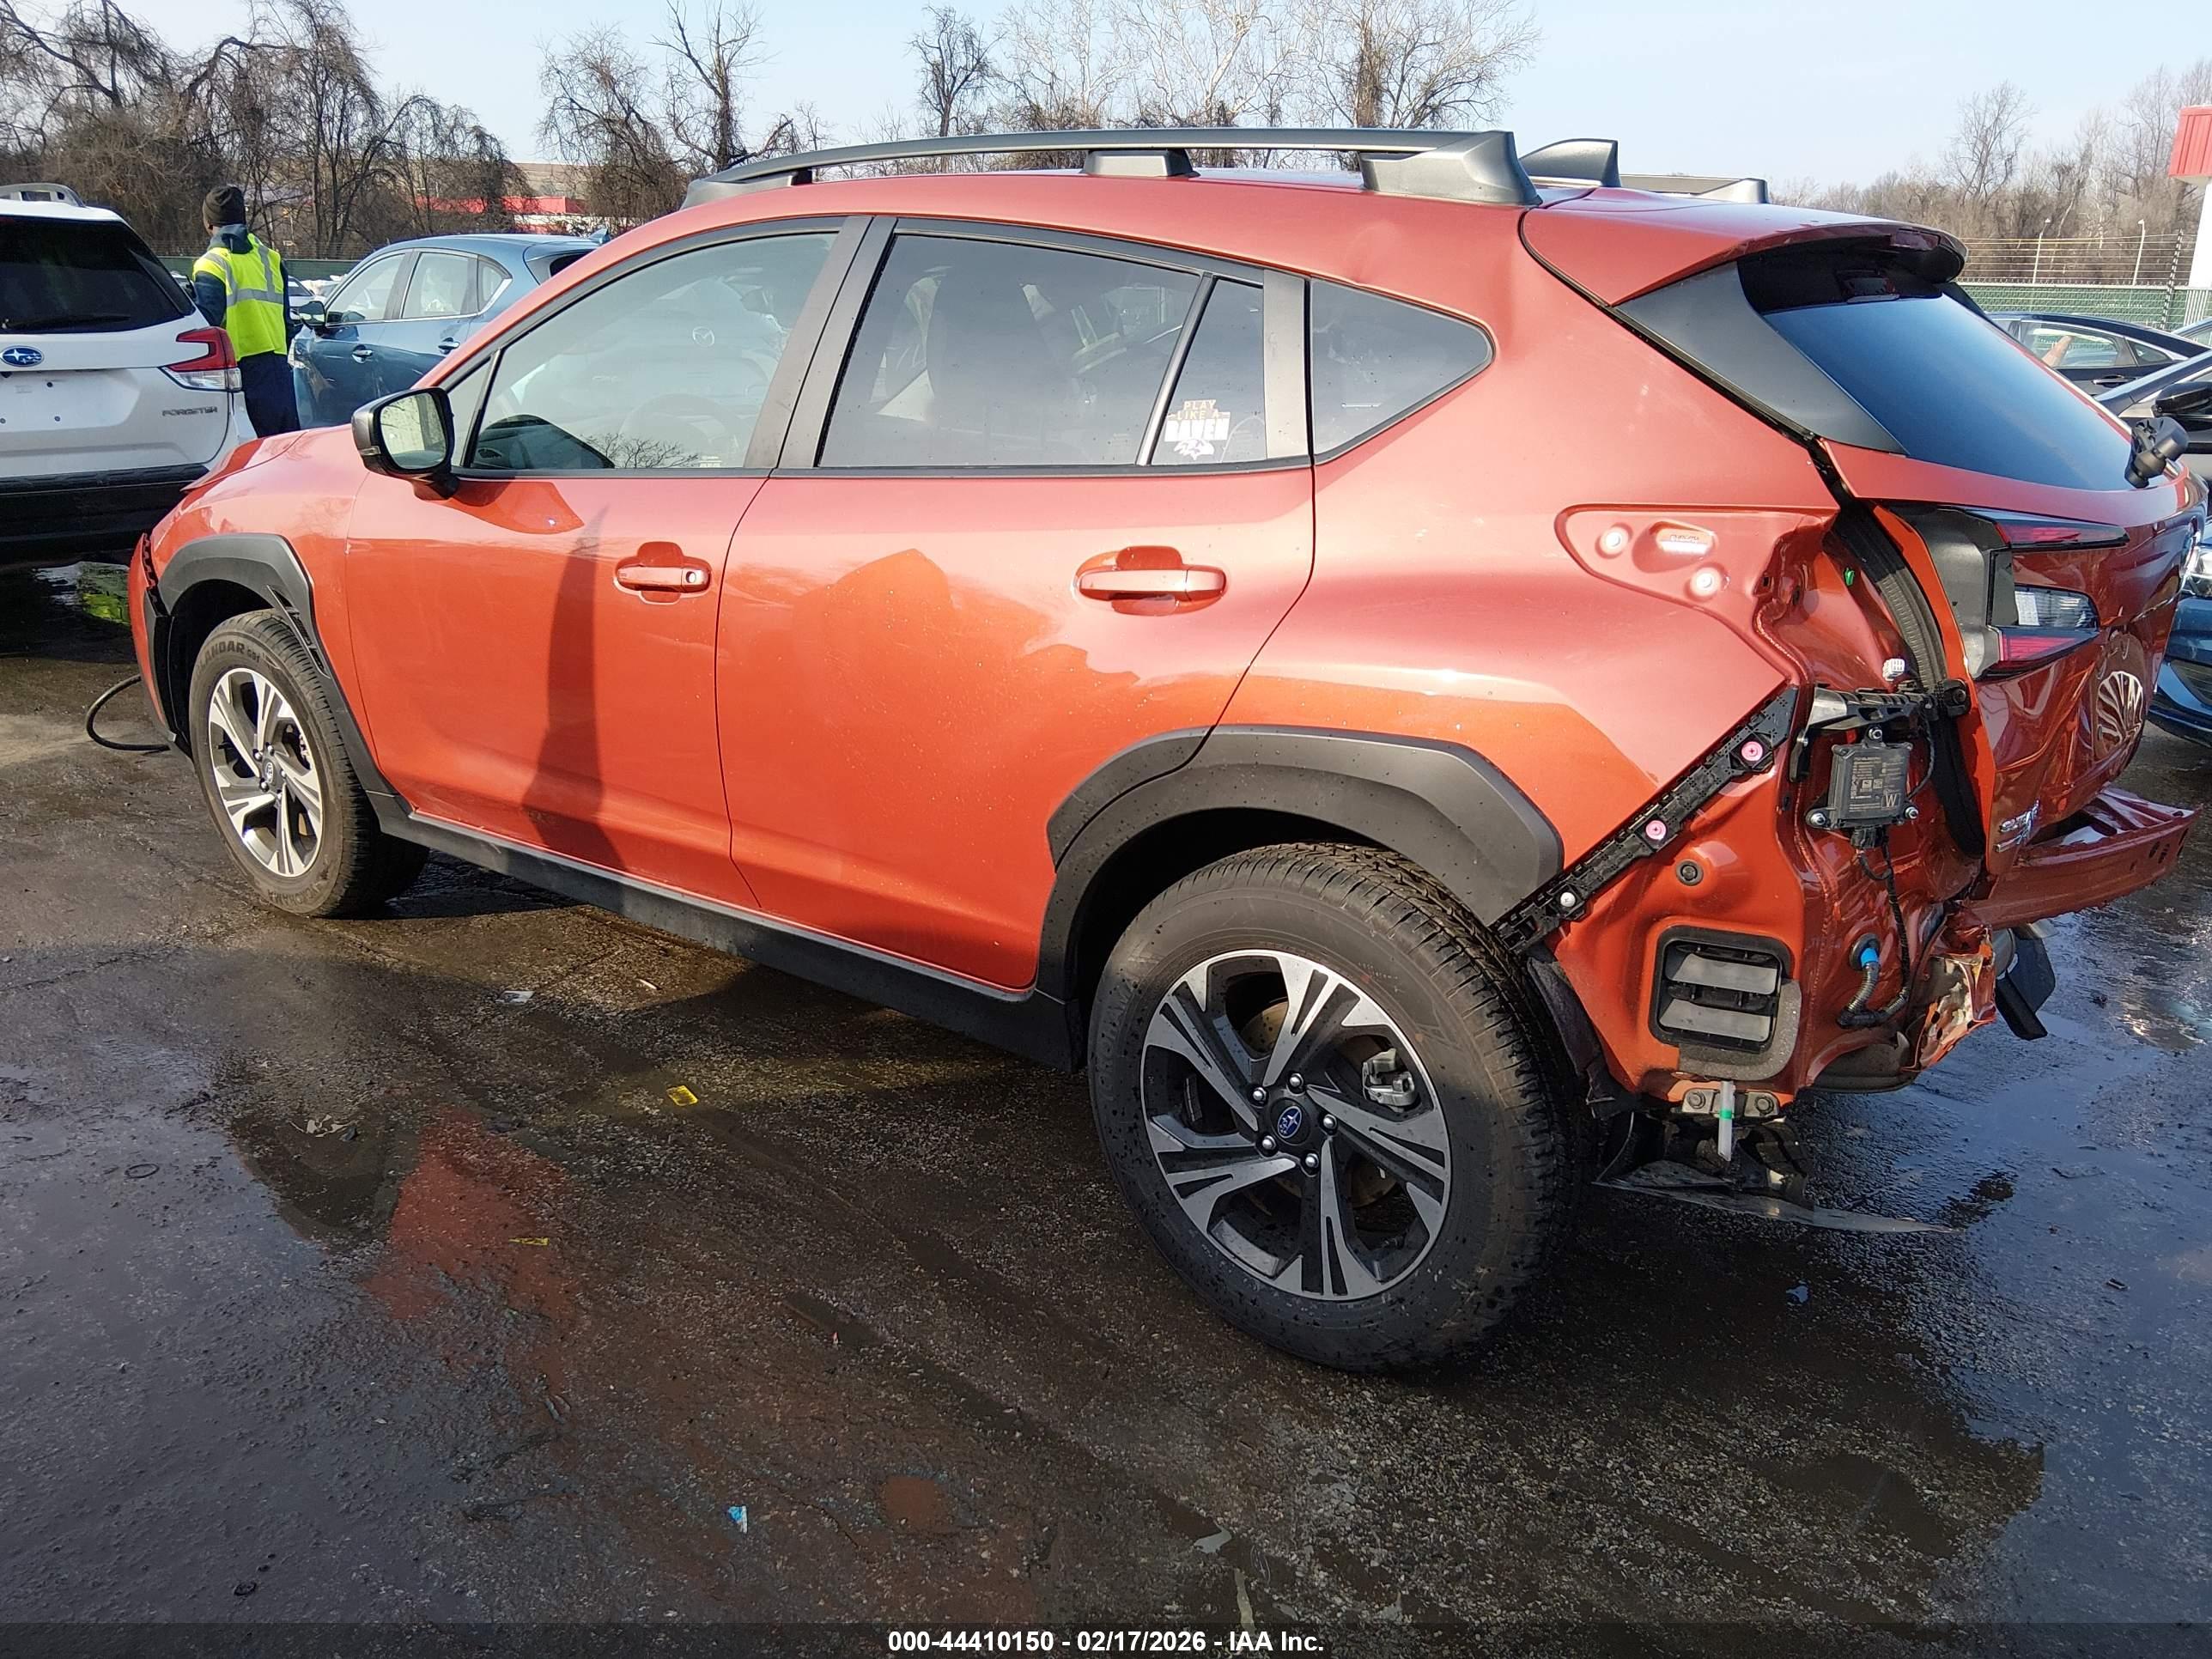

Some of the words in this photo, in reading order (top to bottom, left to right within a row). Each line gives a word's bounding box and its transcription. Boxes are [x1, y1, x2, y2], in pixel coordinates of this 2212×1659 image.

[1183, 399, 1217, 410] PLAY
[161, 406, 218, 416] FORESTER
[1177, 410, 1206, 420] LIKE
[1212, 409, 1220, 419] A
[1164, 418, 1230, 442] RAVEN
[1885, 793, 1897, 808] W
